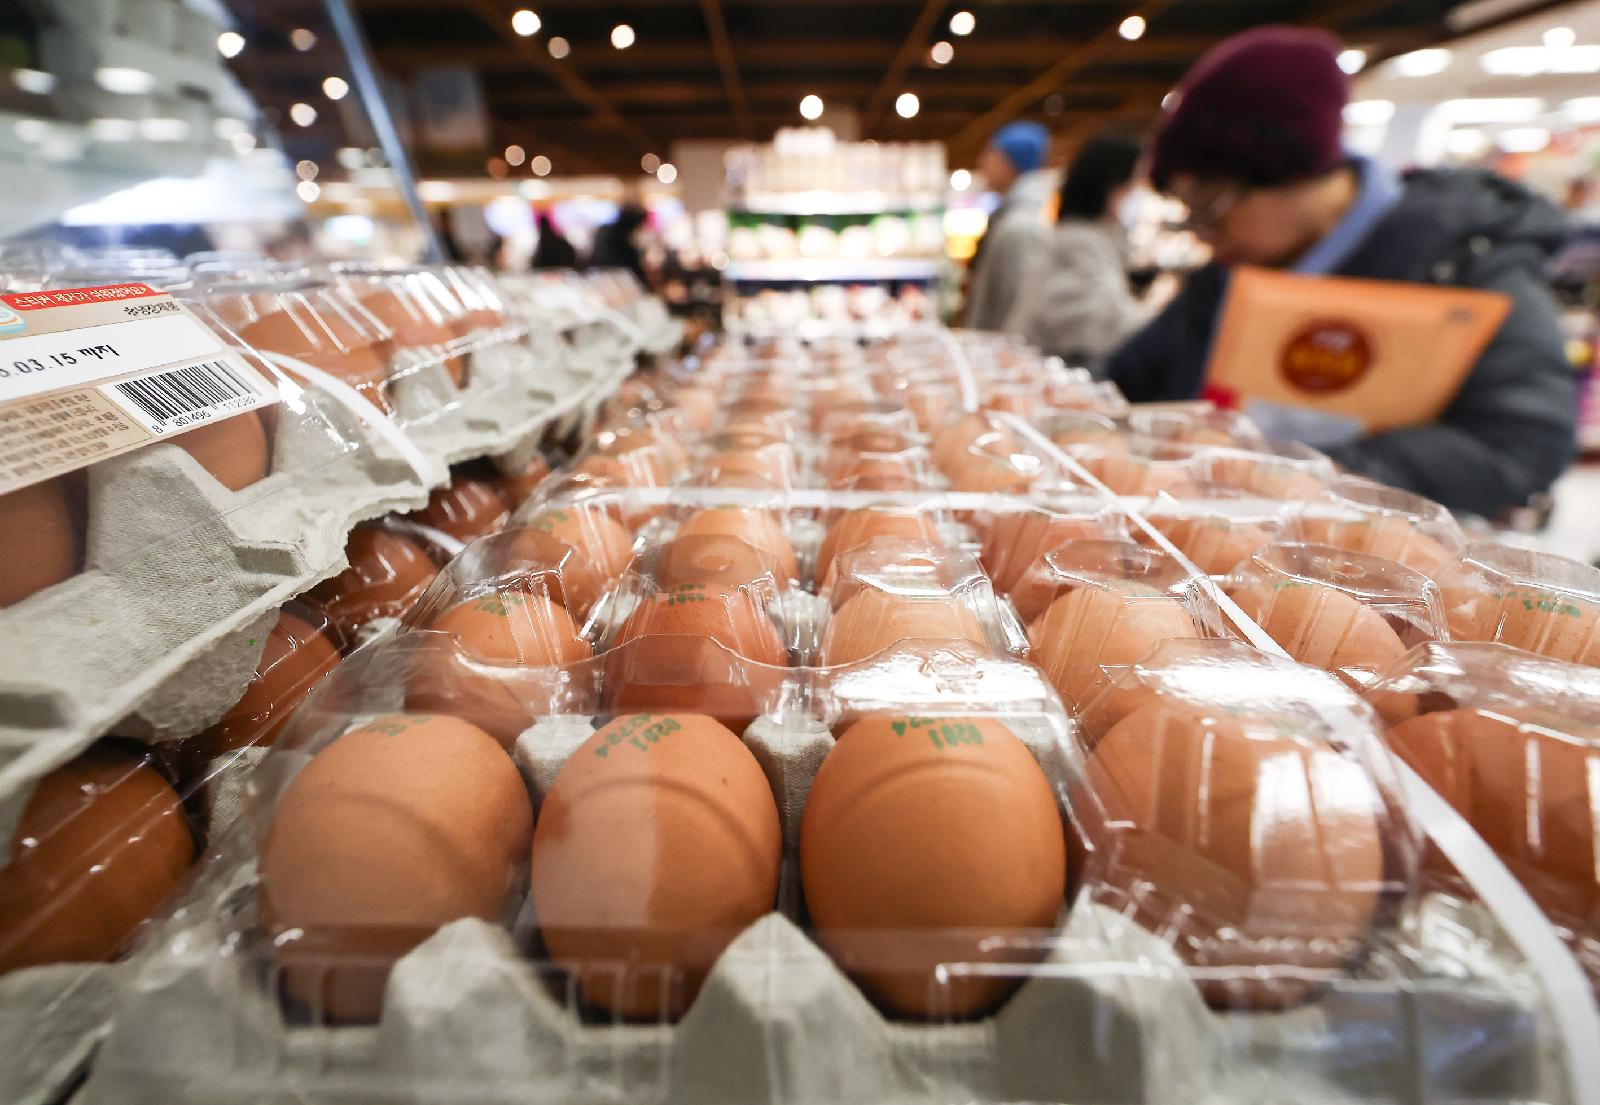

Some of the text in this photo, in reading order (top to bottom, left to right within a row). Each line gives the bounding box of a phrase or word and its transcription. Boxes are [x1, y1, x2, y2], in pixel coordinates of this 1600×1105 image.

[15, 294, 57, 307] 스티커
[51, 292, 92, 304] 제거가
[78, 344, 120, 360] 까지
[172, 409, 211, 427] 801496
